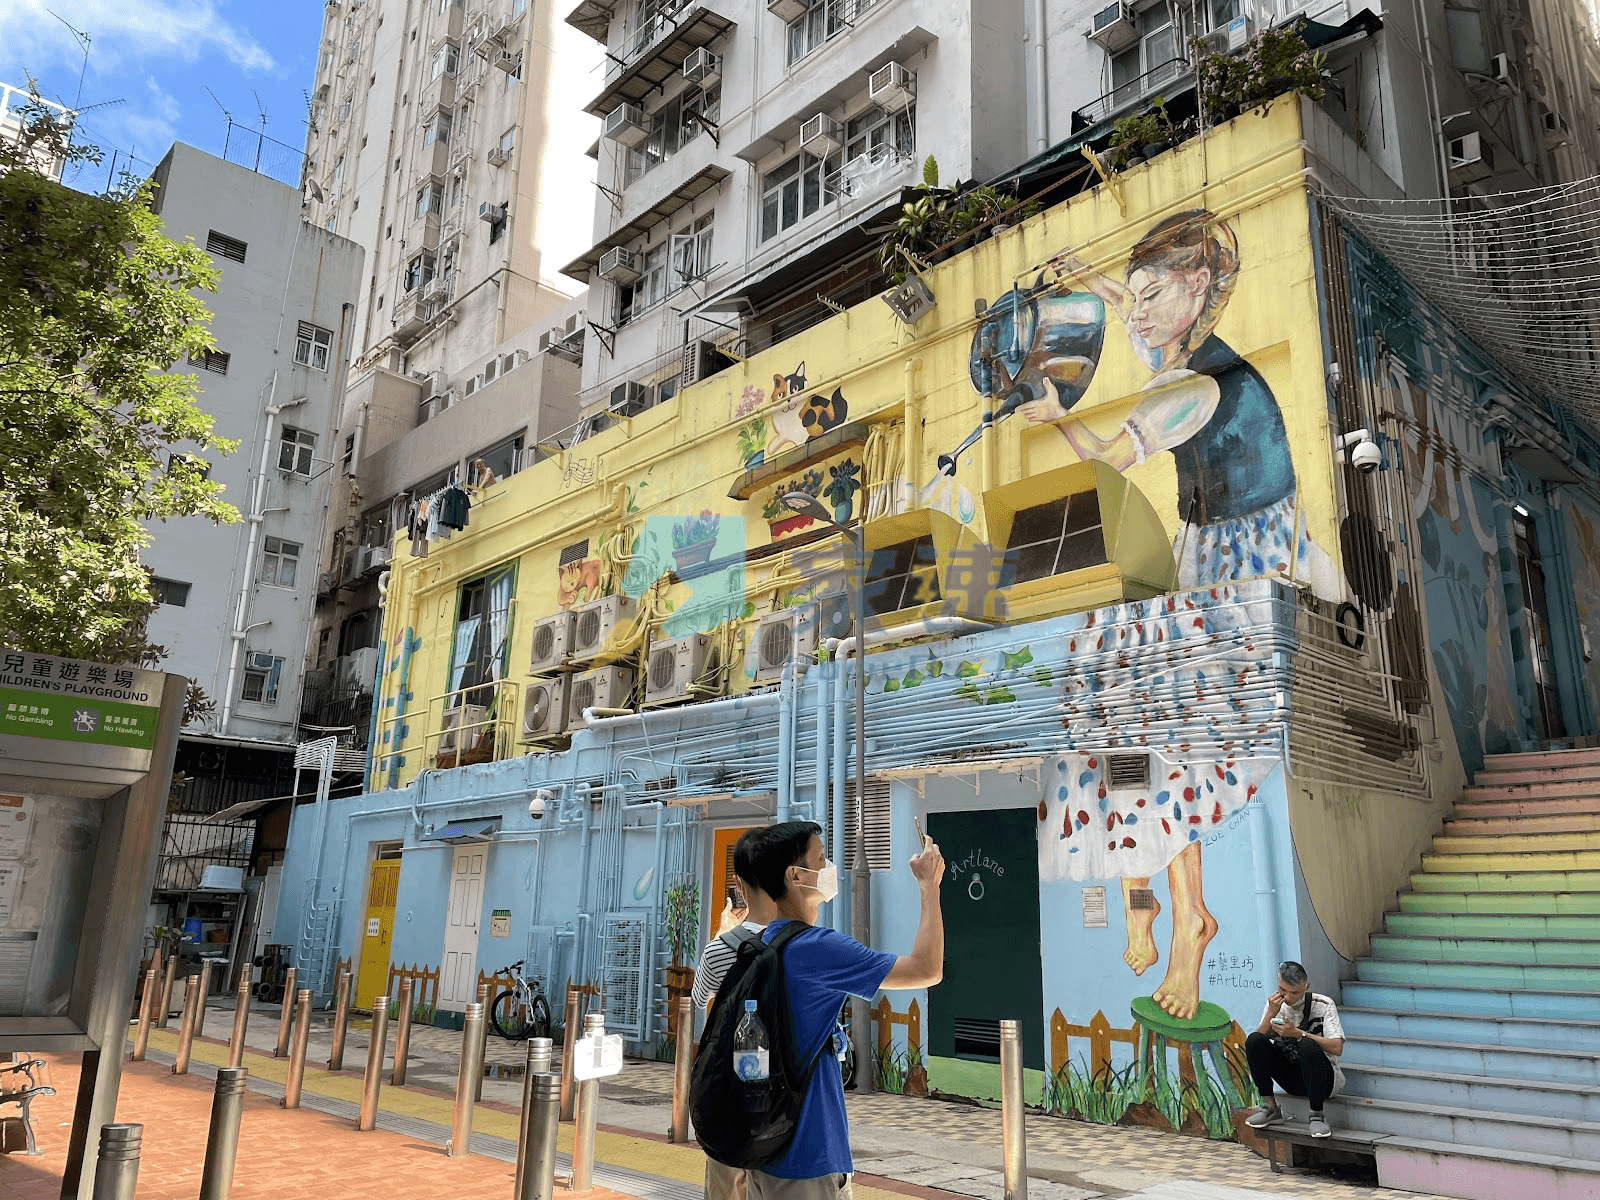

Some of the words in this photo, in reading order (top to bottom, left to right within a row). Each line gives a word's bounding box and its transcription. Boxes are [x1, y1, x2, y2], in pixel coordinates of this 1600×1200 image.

[2, 654, 134, 688] 兒童遊樂場
[0, 674, 61, 691] ILDREN'S
[64, 683, 149, 702] PLAYGROUND
[5, 713, 17, 721] No
[18, 714, 54, 727] Gambling
[115, 726, 145, 737] Hawking
[1229, 810, 1250, 830] CHAN
[950, 848, 1005, 881] Artlane
[1208, 973, 1263, 989] #Artlane
